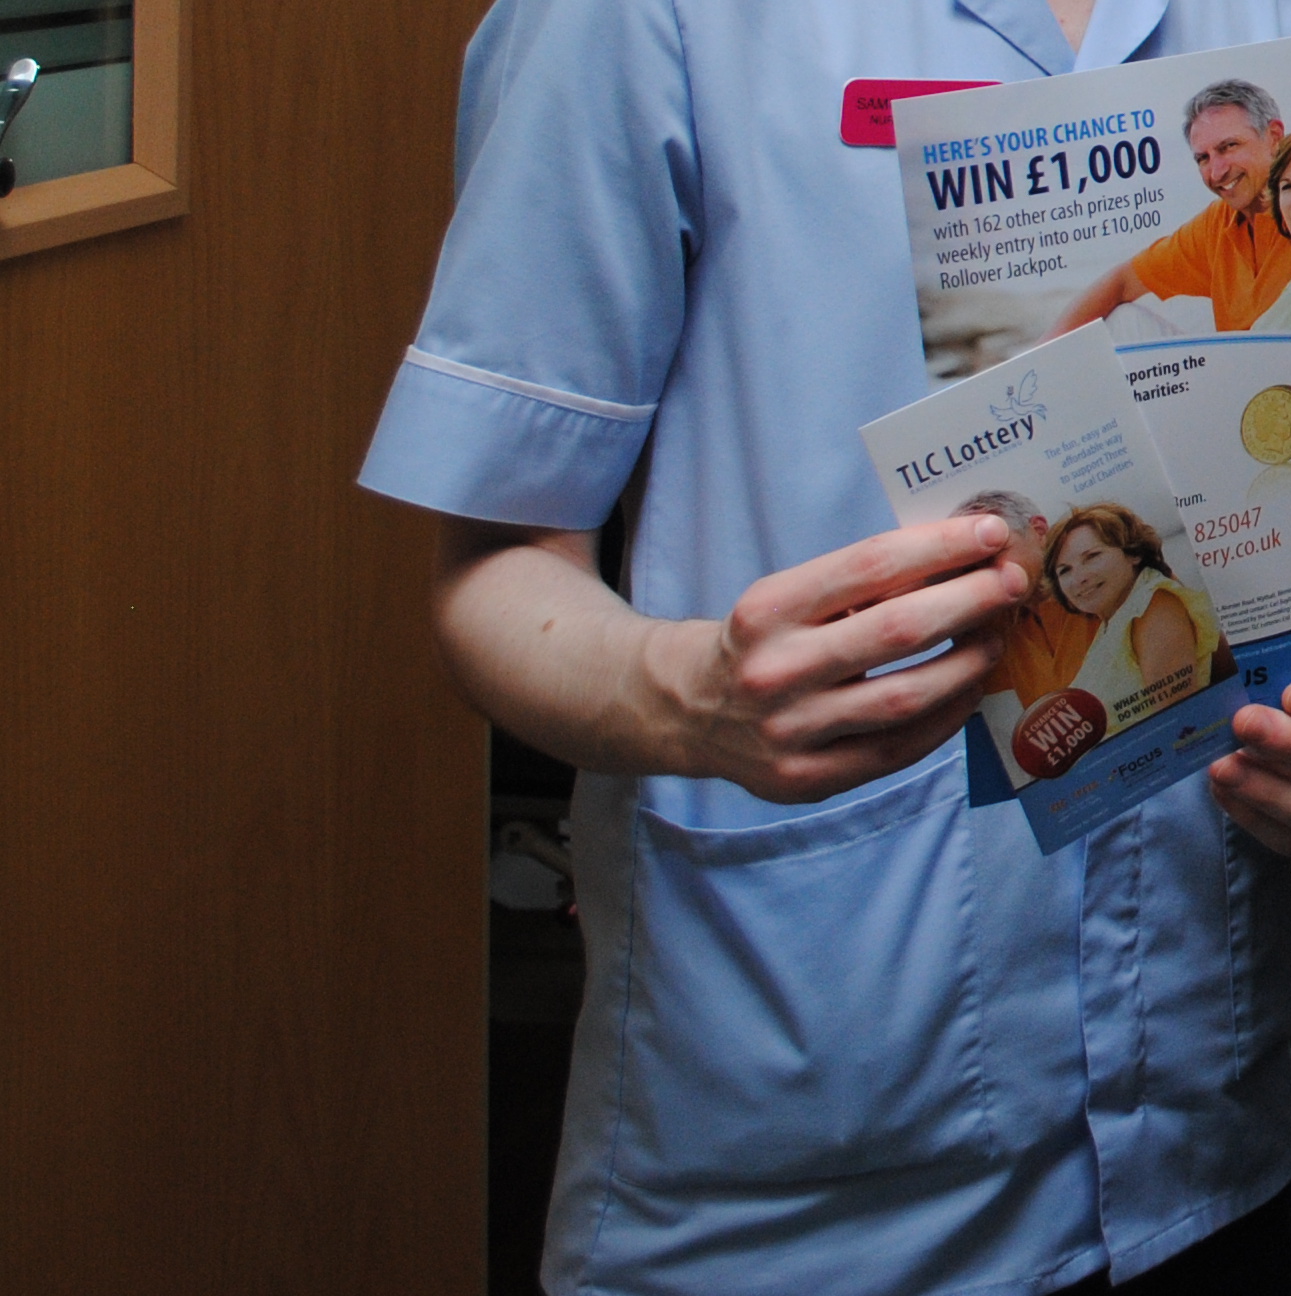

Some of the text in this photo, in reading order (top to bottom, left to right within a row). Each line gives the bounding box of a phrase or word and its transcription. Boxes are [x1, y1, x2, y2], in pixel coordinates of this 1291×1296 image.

[923, 109, 1154, 164] HERE'S YOUR CHANCE TO
[927, 136, 1160, 210] WIN £1,000
[934, 187, 1164, 240] with 162 other cash prizes plus
[937, 210, 1160, 265] weekly entry into our £10,000
[940, 255, 1067, 289] Rollover Jackpot.
[896, 415, 1034, 488] TLC Lottery
[1195, 507, 1261, 543] 825047
[1113, 665, 1193, 711] WHAT WOULD YOU
[1118, 712, 1131, 722] DO
[1132, 695, 1157, 714] WITH
[1029, 704, 1083, 751] WIN
[1046, 720, 1093, 766] £1,000
